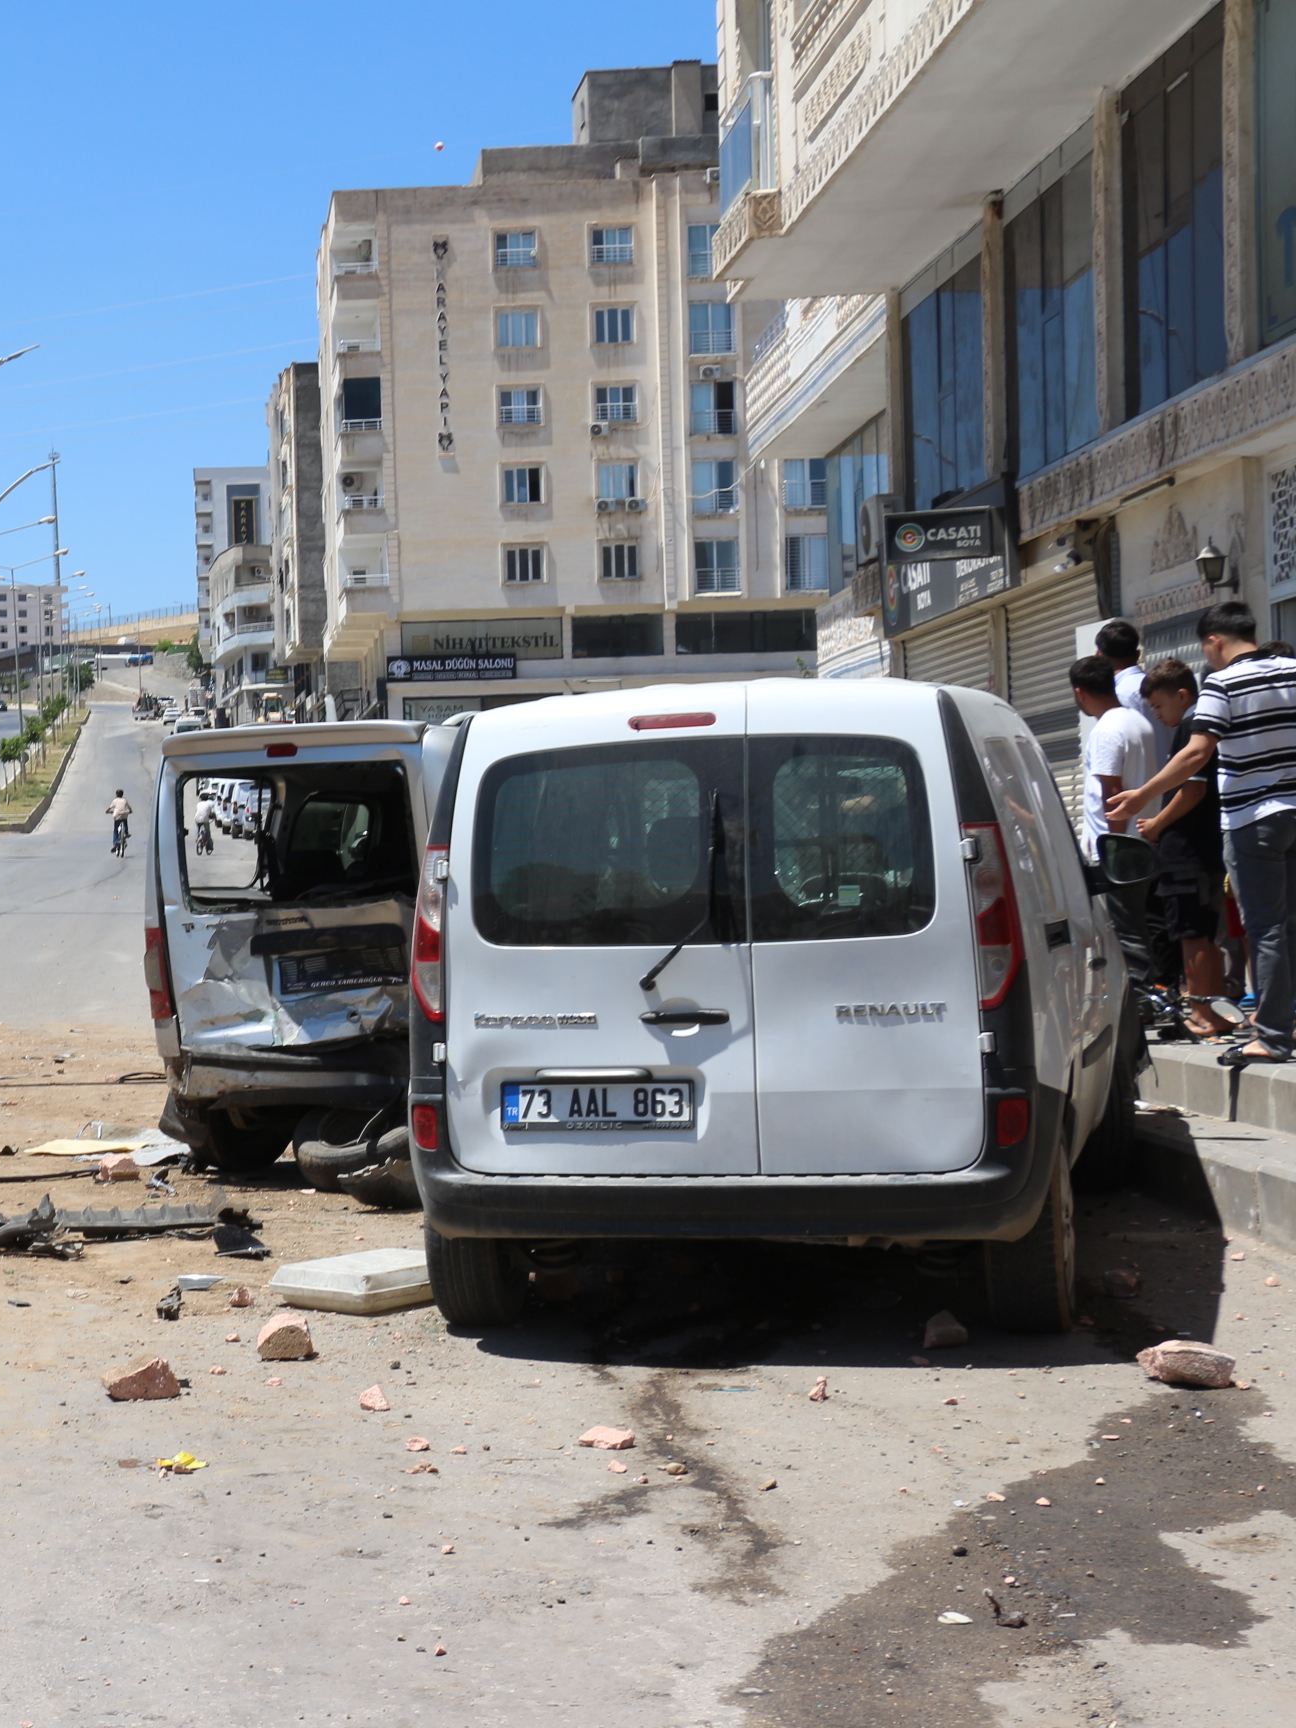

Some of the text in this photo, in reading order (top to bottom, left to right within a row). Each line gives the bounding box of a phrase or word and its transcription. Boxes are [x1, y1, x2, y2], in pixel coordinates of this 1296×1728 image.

[927, 525, 982, 541] CASATI
[956, 538, 982, 548] BOYA
[916, 590, 932, 611] BOYA
[434, 632, 559, 650] NİHAT TEKSTİL
[413, 657, 514, 671] MASAL DÜĞÜN SALONU
[834, 1001, 946, 1018] RENAULT
[506, 1087, 684, 1119] TR 73 AAL 863
